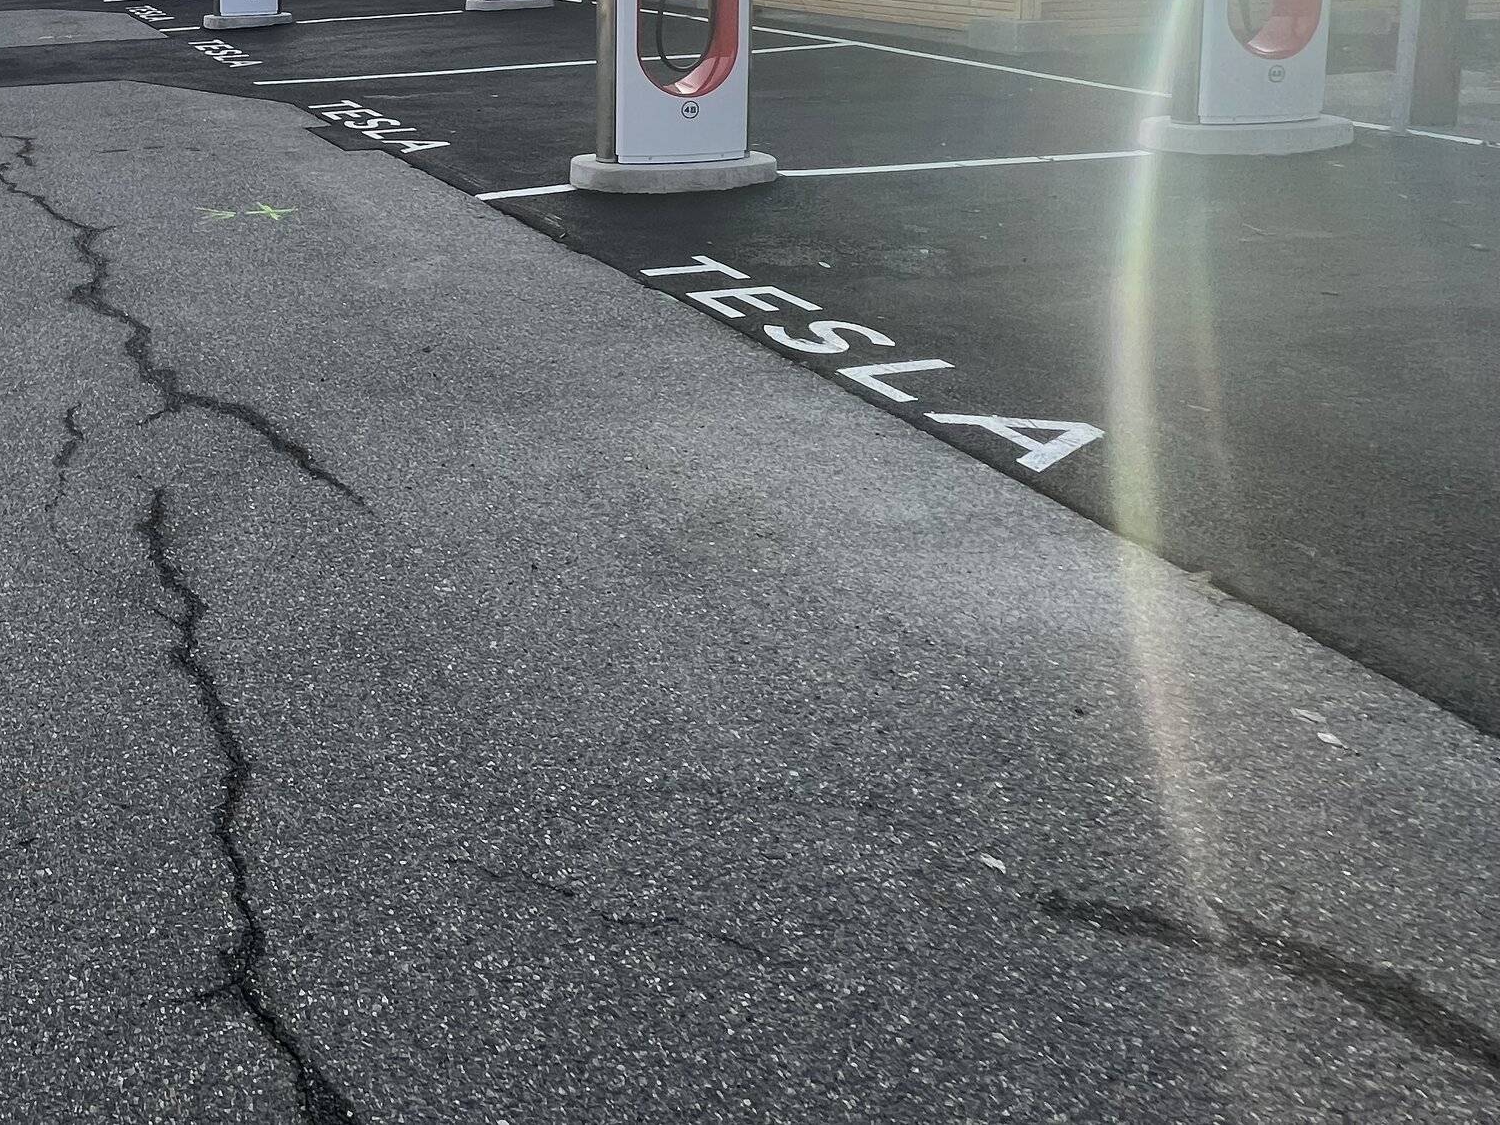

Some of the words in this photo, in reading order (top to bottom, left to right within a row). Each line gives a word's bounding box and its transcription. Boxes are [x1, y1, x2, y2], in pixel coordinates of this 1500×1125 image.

[188, 38, 263, 69] TESLA
[308, 98, 451, 155] TESLA
[640, 255, 1105, 473] TESLA
